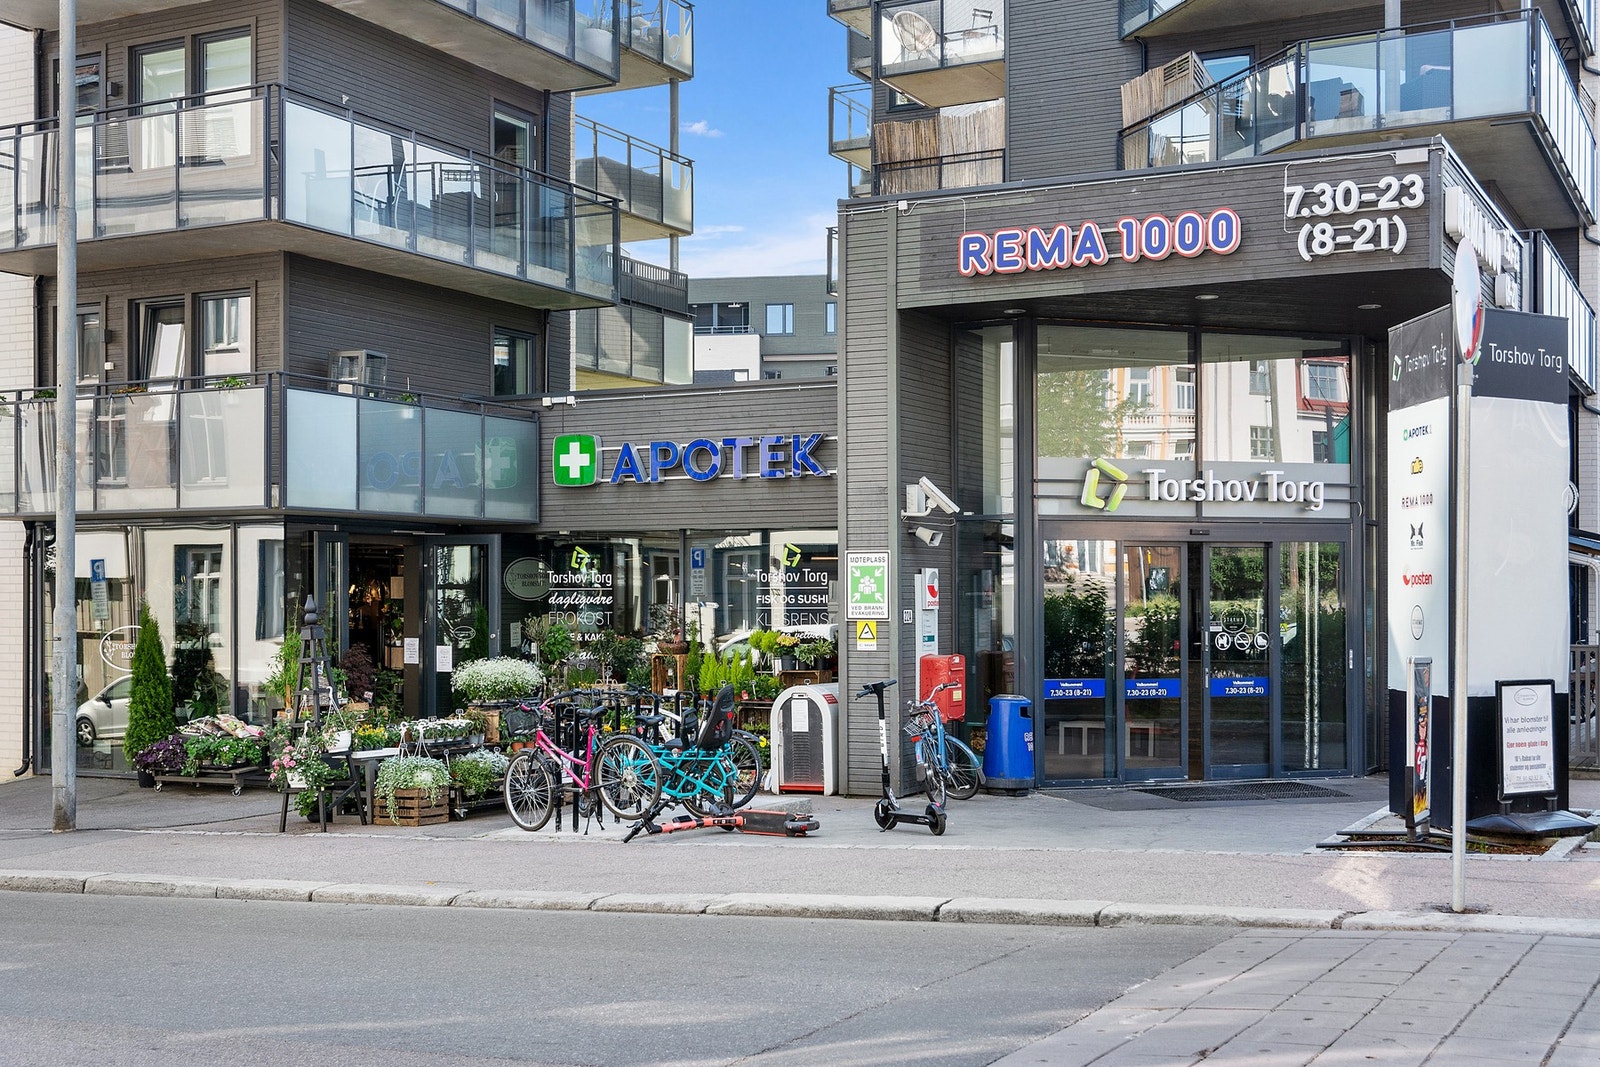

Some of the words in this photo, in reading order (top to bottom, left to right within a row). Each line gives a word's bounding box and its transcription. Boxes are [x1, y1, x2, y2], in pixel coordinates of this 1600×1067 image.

[958, 220, 1109, 276] REMA
[1117, 207, 1241, 264] 1000
[1297, 215, 1407, 263] (8-21)
[1405, 354, 1430, 373] Torshov
[1489, 343, 1536, 366] Torshov
[1538, 348, 1563, 373] Torg
[1408, 424, 1429, 438] APOTEK
[609, 433, 831, 484] APOTEK
[1142, 468, 1259, 502] Torshov
[1261, 470, 1325, 511] Torg
[1402, 496, 1419, 508] REMA
[1420, 493, 1434, 506] 1000
[547, 571, 587, 583] Torshov
[590, 571, 612, 586] Torg
[755, 569, 800, 582] Torshov
[802, 568, 828, 585] Torg
[1411, 571, 1433, 587] posten
[548, 591, 614, 608] dagligvare
[756, 595, 777, 604] FISK
[781, 595, 795, 604] OG
[797, 594, 828, 604] SUSHI
[548, 611, 613, 625] FROKOST
[755, 612, 829, 626] KLSRENS
[576, 632, 583, 641] &
[1074, 689, 1092, 697] (8-21)
[1247, 687, 1264, 695] (8-21)
[1510, 716, 1520, 724] har
[1520, 715, 1543, 723] blomster
